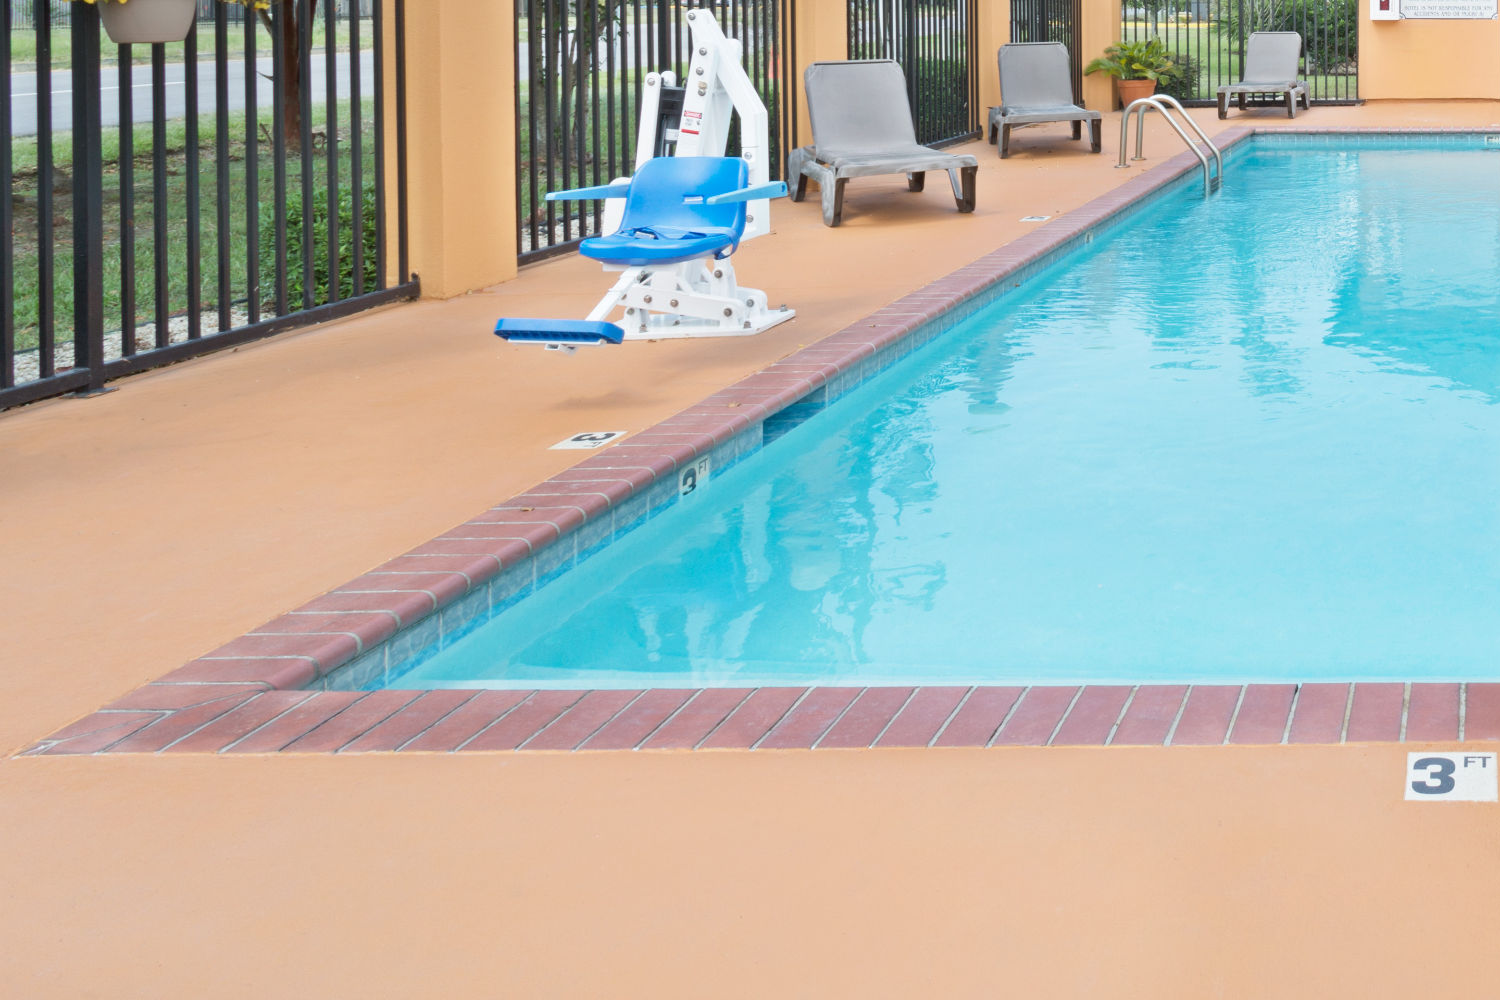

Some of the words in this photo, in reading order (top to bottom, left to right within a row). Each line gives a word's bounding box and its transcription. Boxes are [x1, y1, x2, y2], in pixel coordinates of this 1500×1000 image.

[571, 433, 616, 441] 3
[682, 467, 697, 496] 3
[698, 457, 709, 475] FT
[1411, 757, 1456, 795] 3
[1464, 756, 1492, 768] FT
